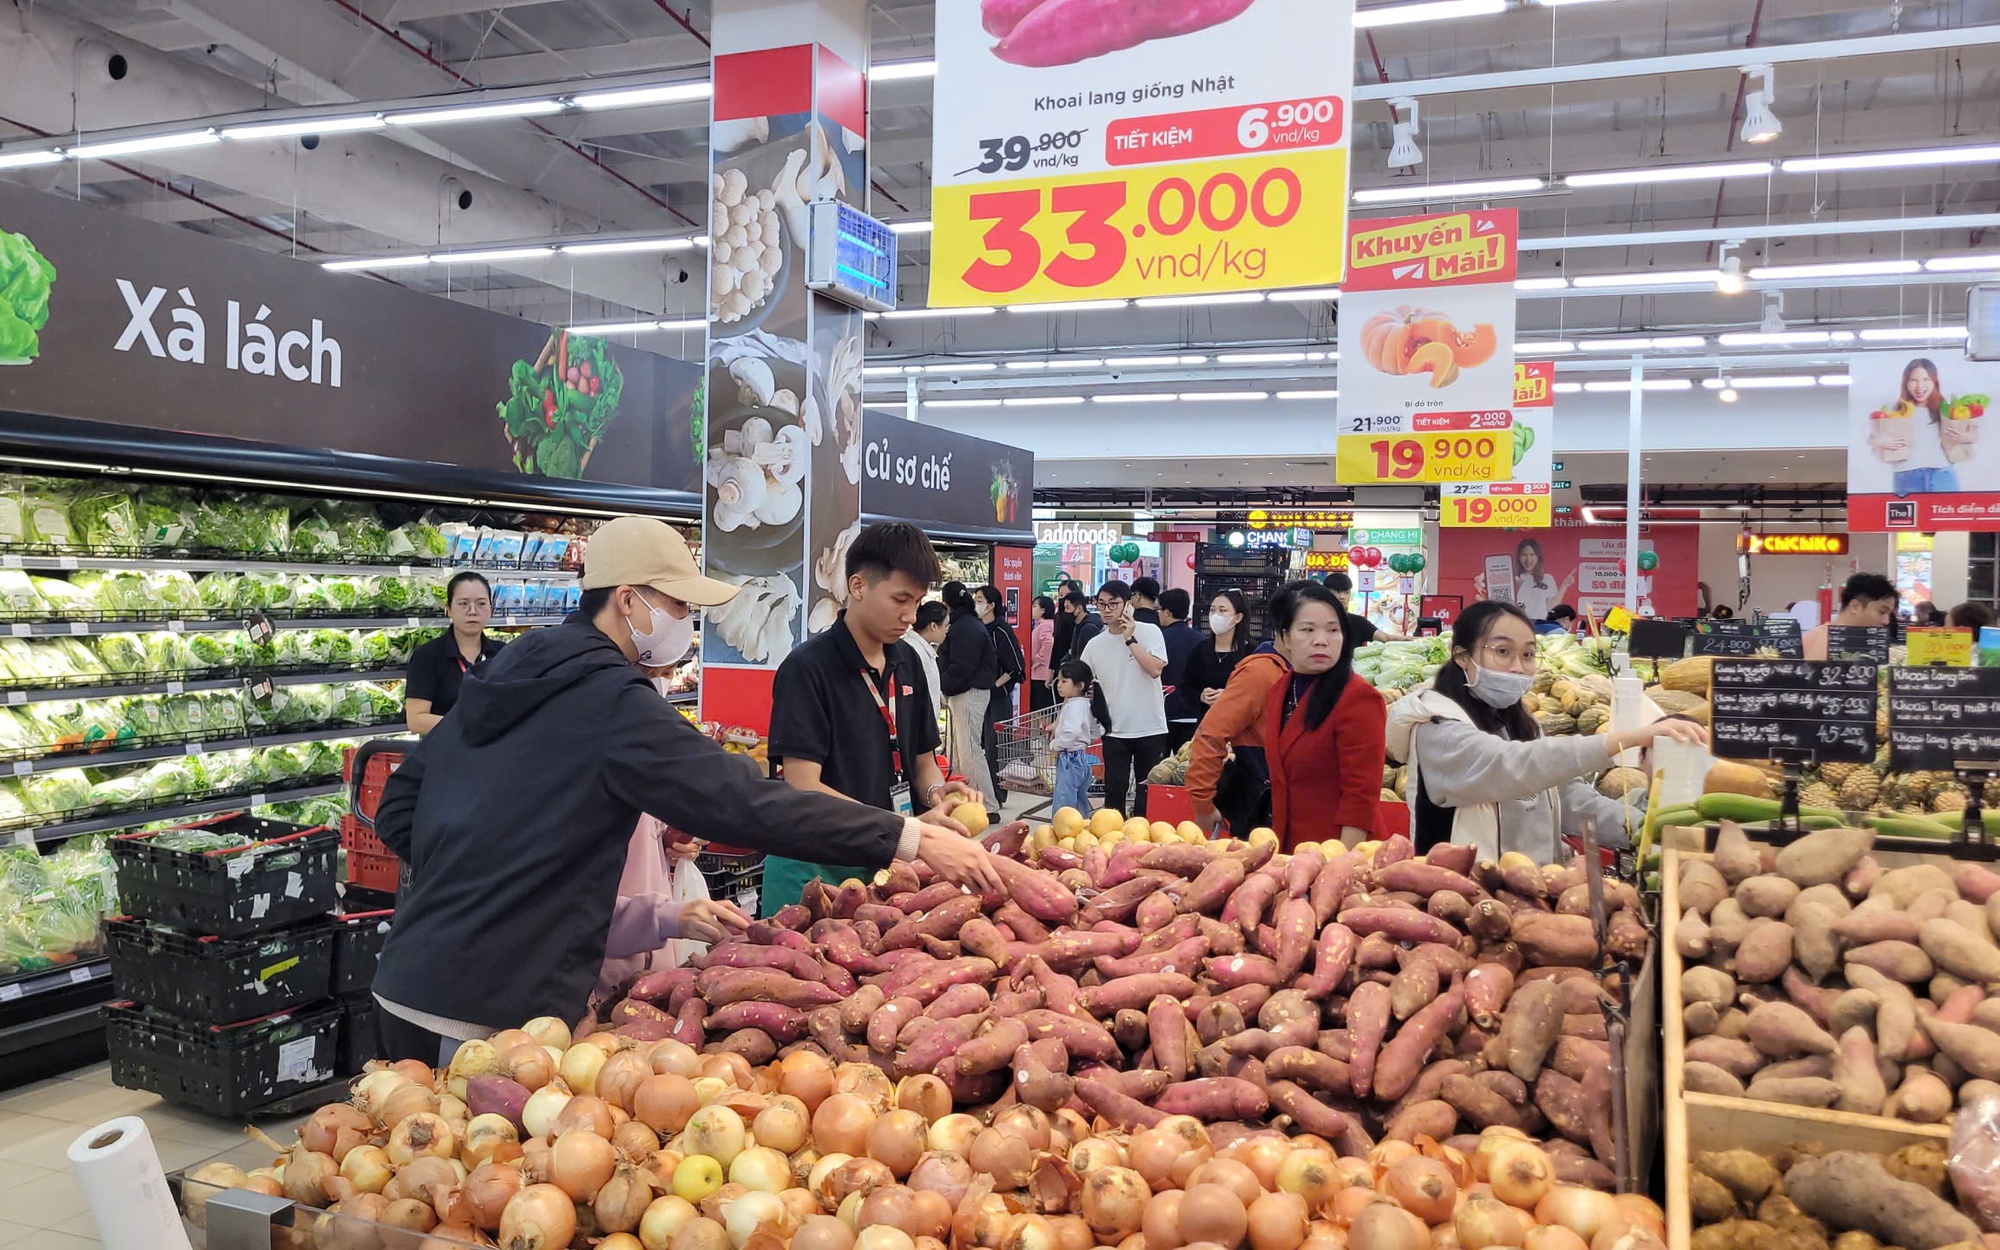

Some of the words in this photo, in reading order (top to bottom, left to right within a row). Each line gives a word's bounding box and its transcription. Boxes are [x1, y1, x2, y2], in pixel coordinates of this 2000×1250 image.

[1034, 92, 1083, 111] Khoai
[1088, 90, 1126, 105] lang
[1132, 81, 1184, 103] giống
[1190, 75, 1235, 94] Nhật
[1237, 100, 1334, 149] 6.900
[1113, 128, 1150, 150] TIẾT
[1151, 126, 1193, 147] KIỆM
[1272, 127, 1320, 144] vnd/kg
[1033, 152, 1079, 168] vnd/kg
[961, 167, 1302, 293] 33.000
[1136, 239, 1267, 281] vnd/kg
[1356, 221, 1462, 260] Khuyến
[1435, 236, 1499, 278] Mãi!
[113, 278, 207, 365] Xà
[226, 300, 342, 388] lách
[1414, 399, 1425, 407] đỏ
[1427, 399, 1444, 407] tròn
[1352, 416, 1400, 432] 21.900
[1415, 417, 1431, 426] TIẾT
[1431, 417, 1450, 427] KIỆM
[1469, 411, 1506, 428] 2.000
[865, 437, 891, 481] Củ
[895, 454, 917, 486] sơ
[920, 451, 953, 491] chế
[1370, 438, 1495, 479] 19.900
[1434, 462, 1491, 479] vnd/kg
[1453, 498, 1538, 524] 19.000
[1930, 504, 1955, 514] Tích
[1957, 502, 1985, 514] điểm
[1494, 513, 1529, 525] vnd/kg
[1033, 521, 1118, 545] Ladofoods
[1370, 530, 1405, 539] CHANG
[1407, 530, 1418, 539] HI
[1763, 534, 1840, 551] ChiChiKo
[1363, 577, 1370, 585] 3
[1893, 668, 1929, 681] Khoai
[1931, 668, 1958, 688] lang
[1892, 699, 1929, 711] Khoai
[1931, 700, 1962, 718] lang
[1892, 730, 1925, 743] Khoai
[1926, 733, 1950, 749] lang
